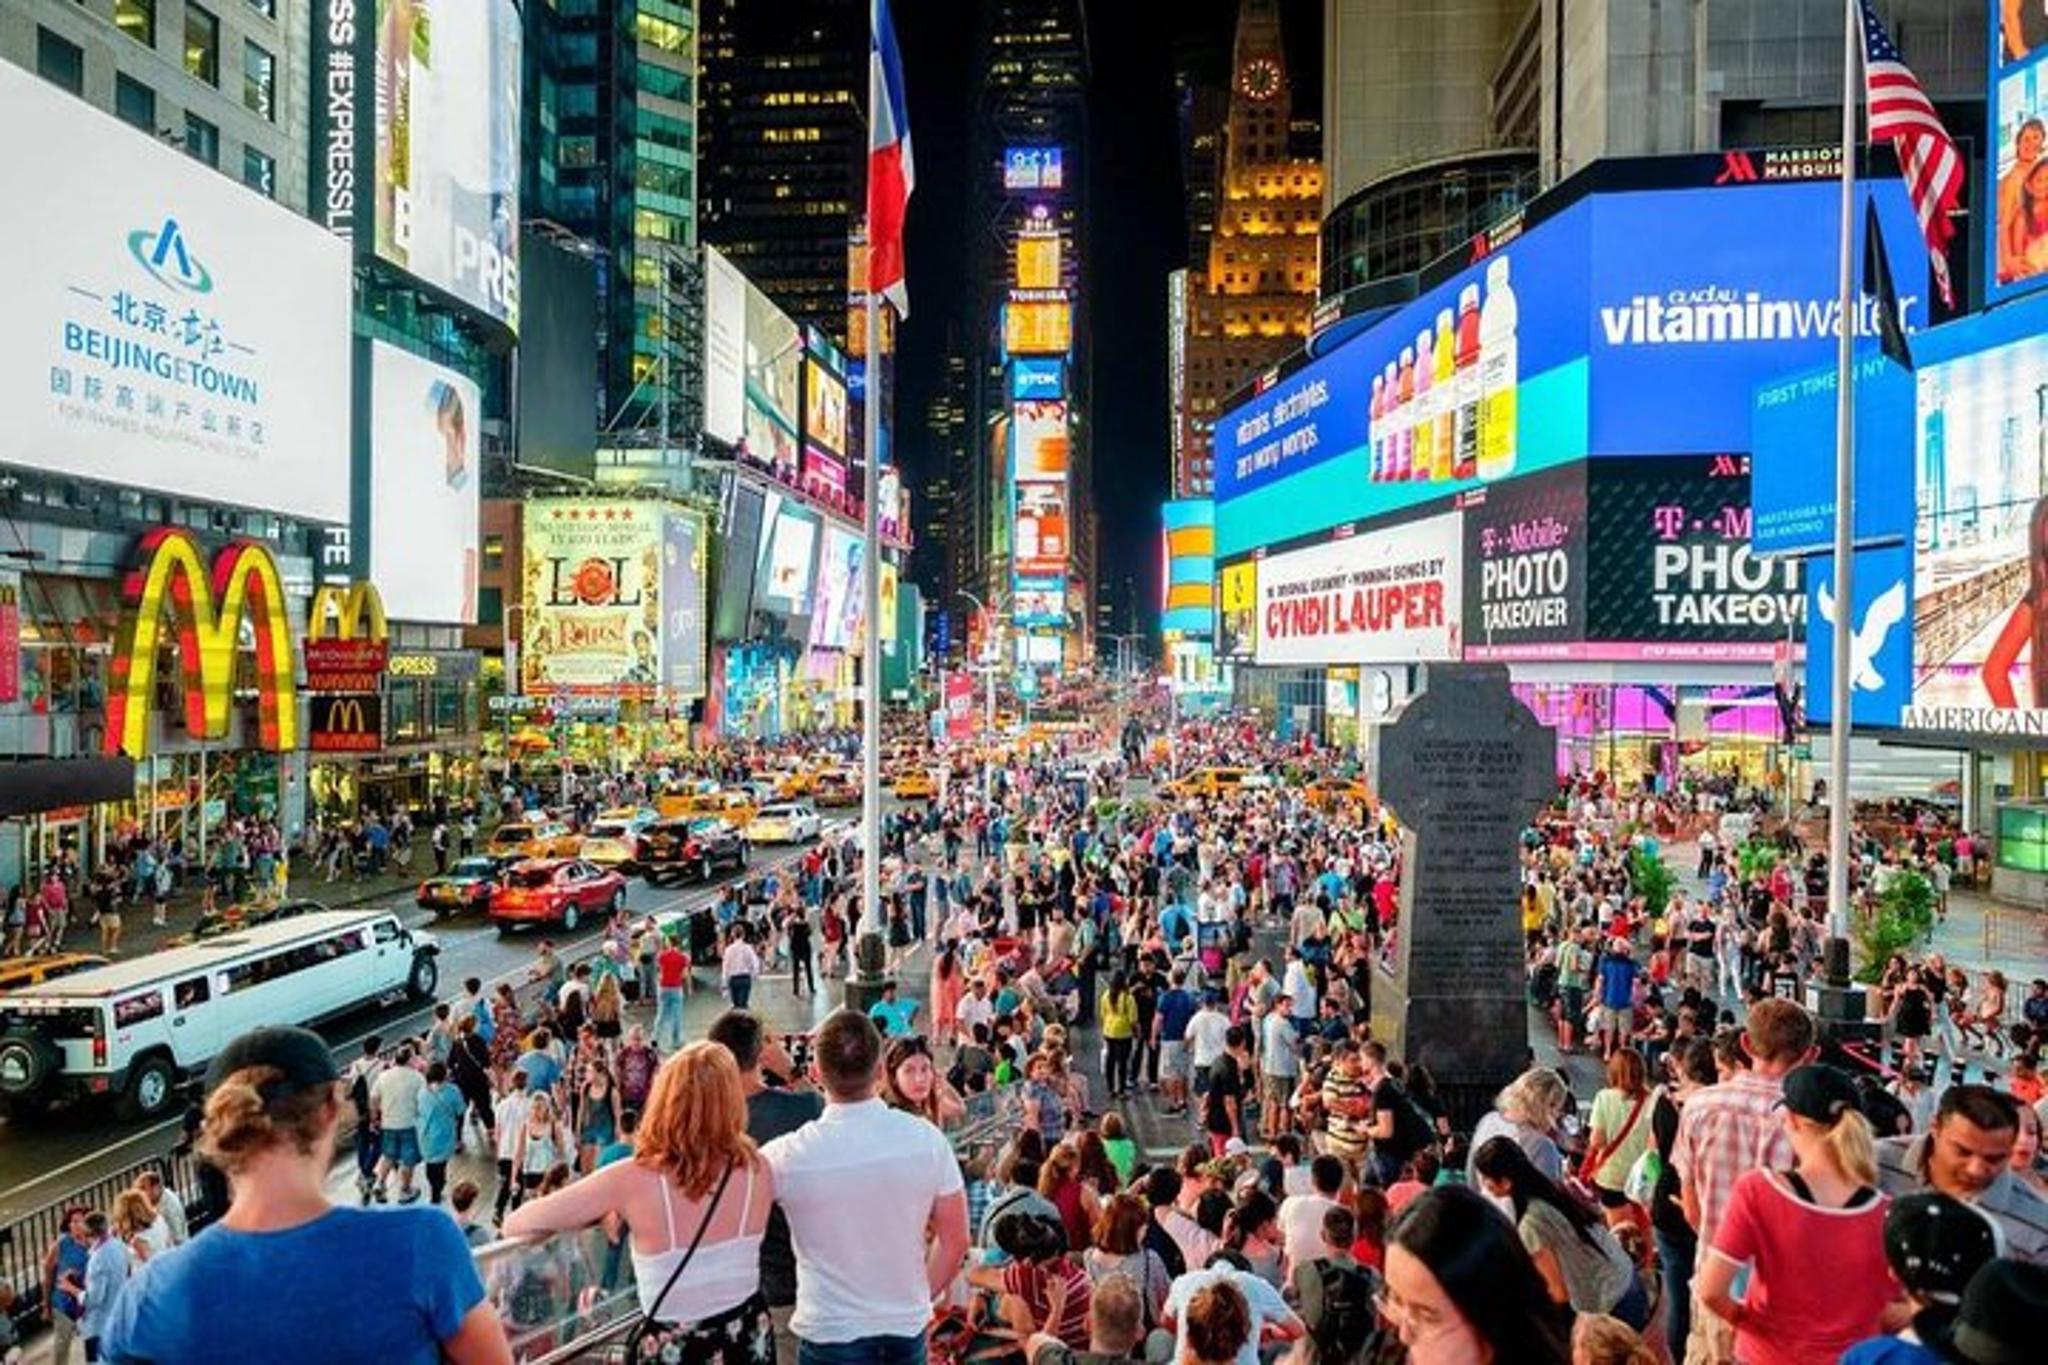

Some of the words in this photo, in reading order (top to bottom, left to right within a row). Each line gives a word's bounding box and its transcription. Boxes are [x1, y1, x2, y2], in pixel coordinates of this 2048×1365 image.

[1765, 147, 1843, 162] MARRIOT
[1481, 549, 1569, 600] PHOTO
[1266, 593, 1329, 639] CYNDI
[1333, 580, 1445, 634] LAUPER
[1481, 595, 1569, 631] TAKEOVER
[1905, 706, 2044, 738] AMERICAN
